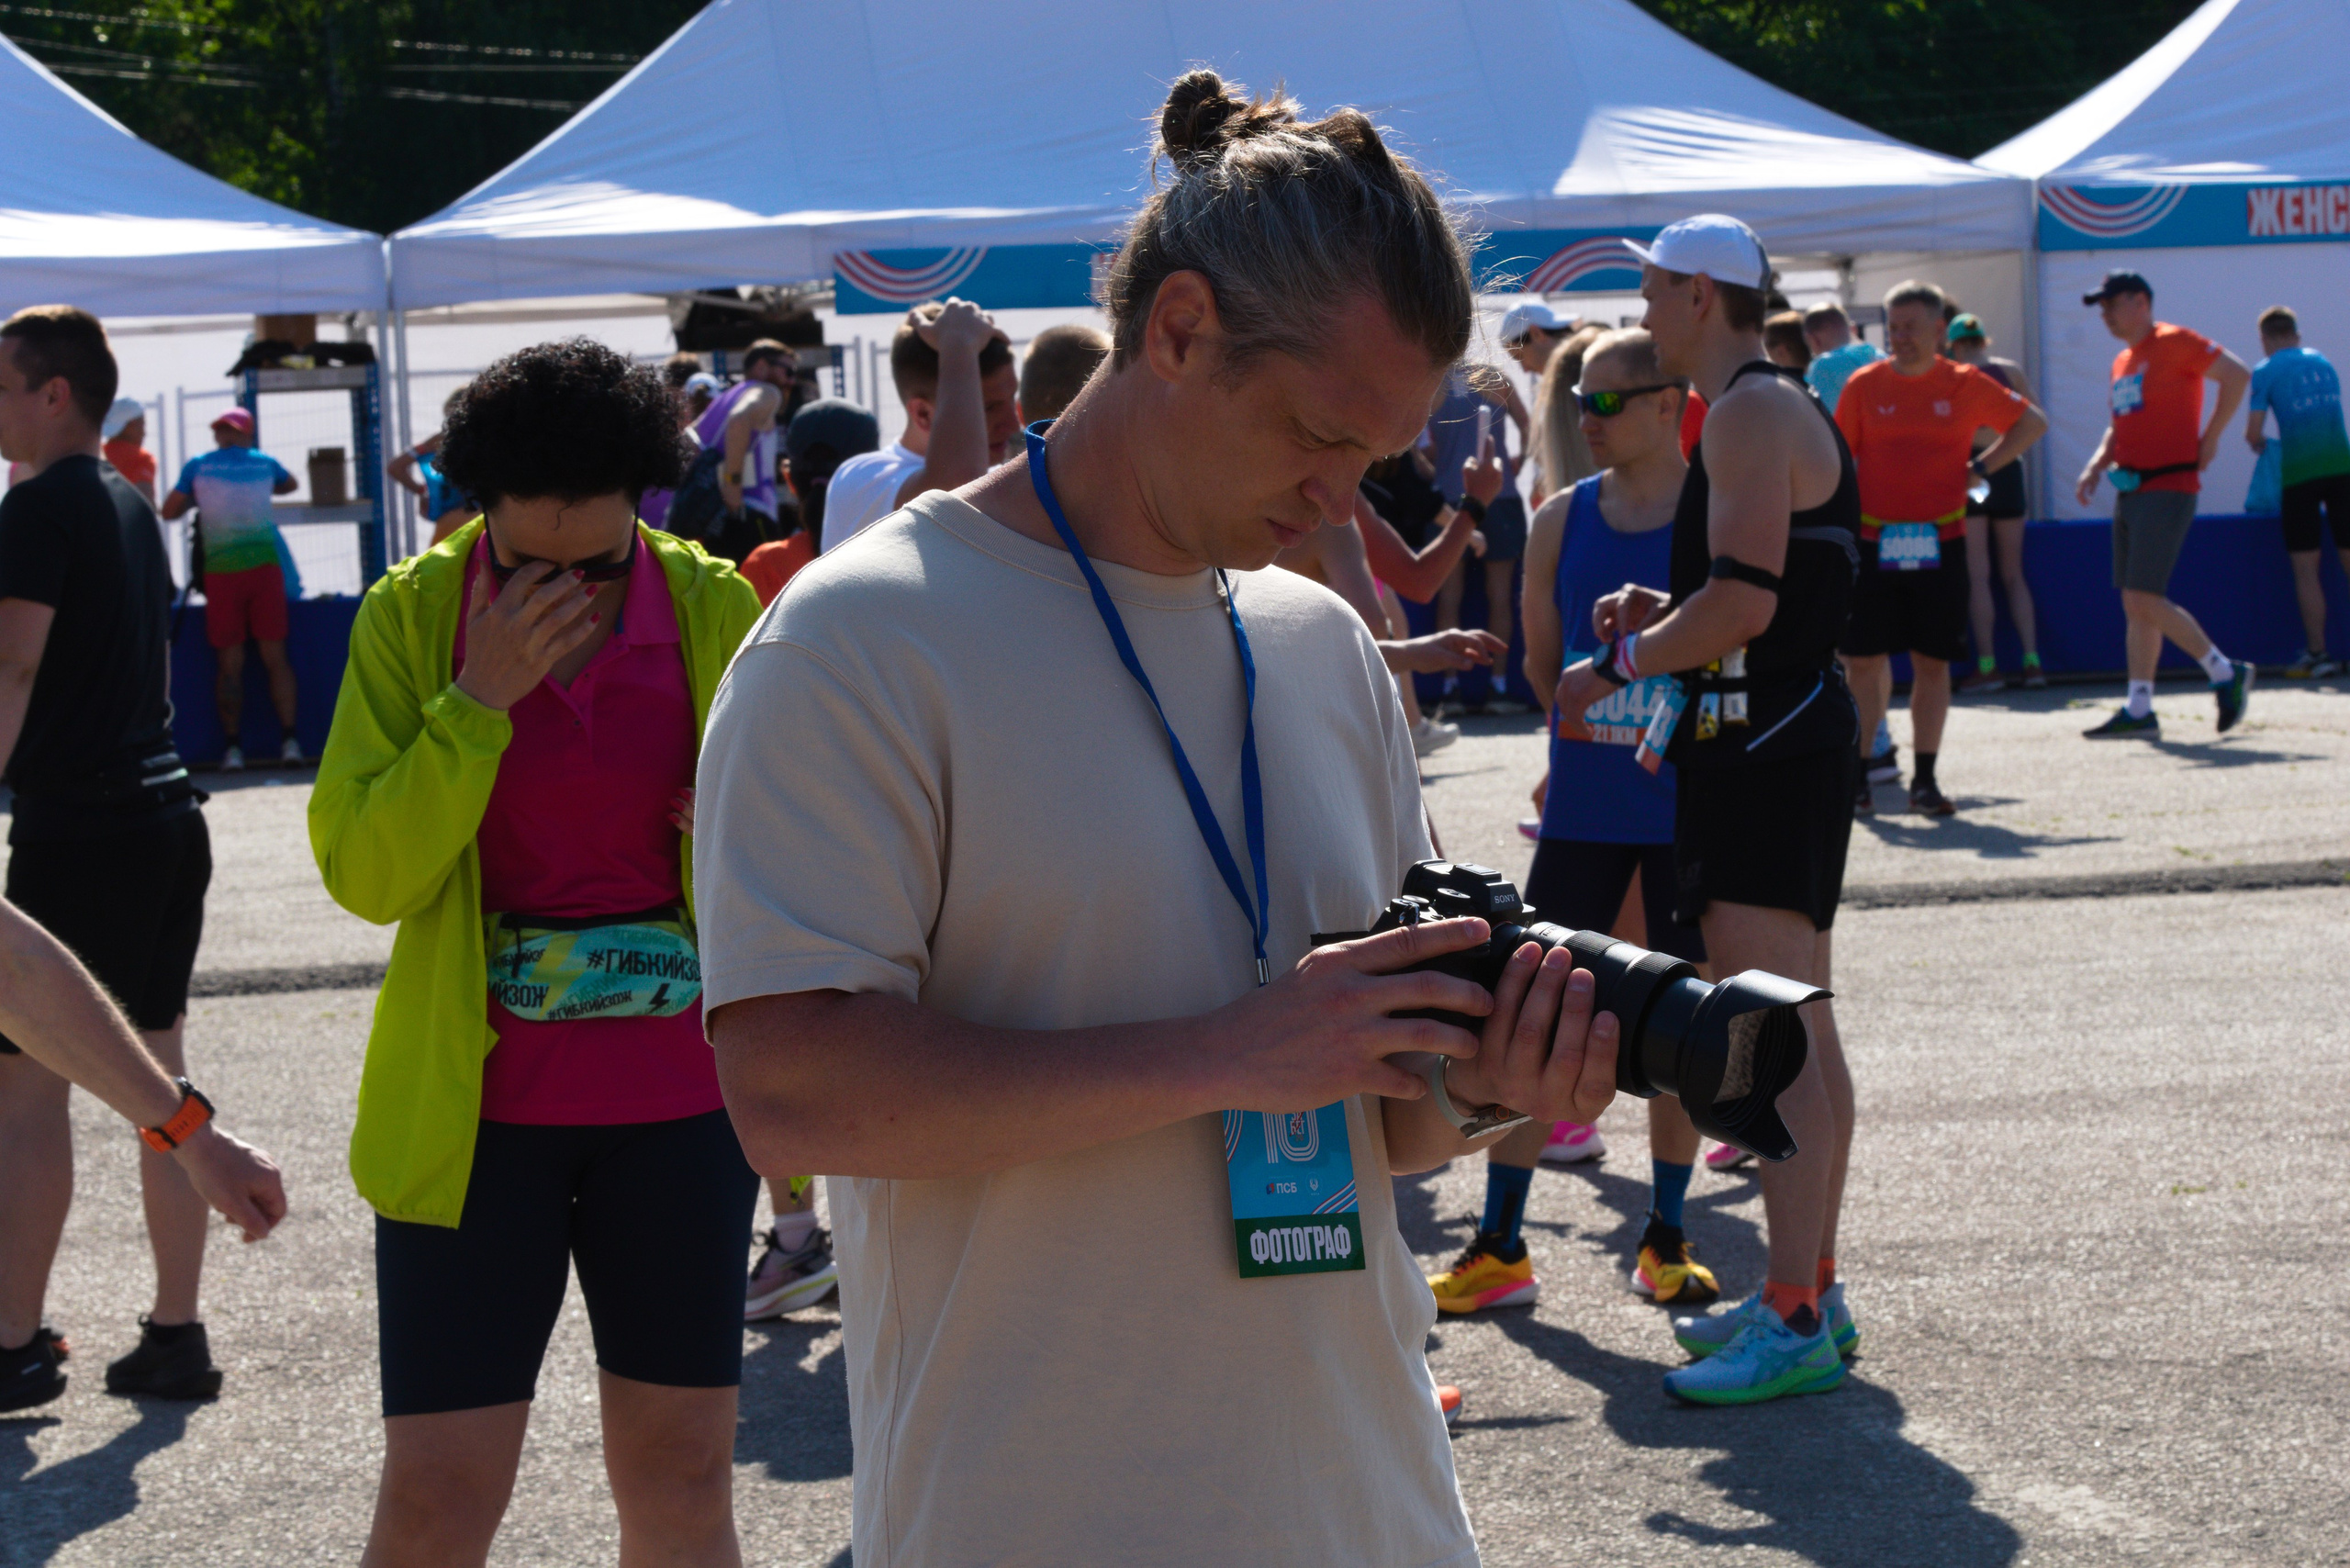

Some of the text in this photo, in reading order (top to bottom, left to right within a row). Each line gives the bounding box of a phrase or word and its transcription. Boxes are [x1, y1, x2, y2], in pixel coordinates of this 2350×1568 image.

[2247, 185, 2346, 236] ЖЕНС
[1494, 894, 1515, 904] SONY
[547, 991, 632, 1021] #ГИБКИЙЗОЖ
[1276, 1182, 1297, 1193] ПСБ
[1250, 1224, 1351, 1264] ФОТОГРАФ
